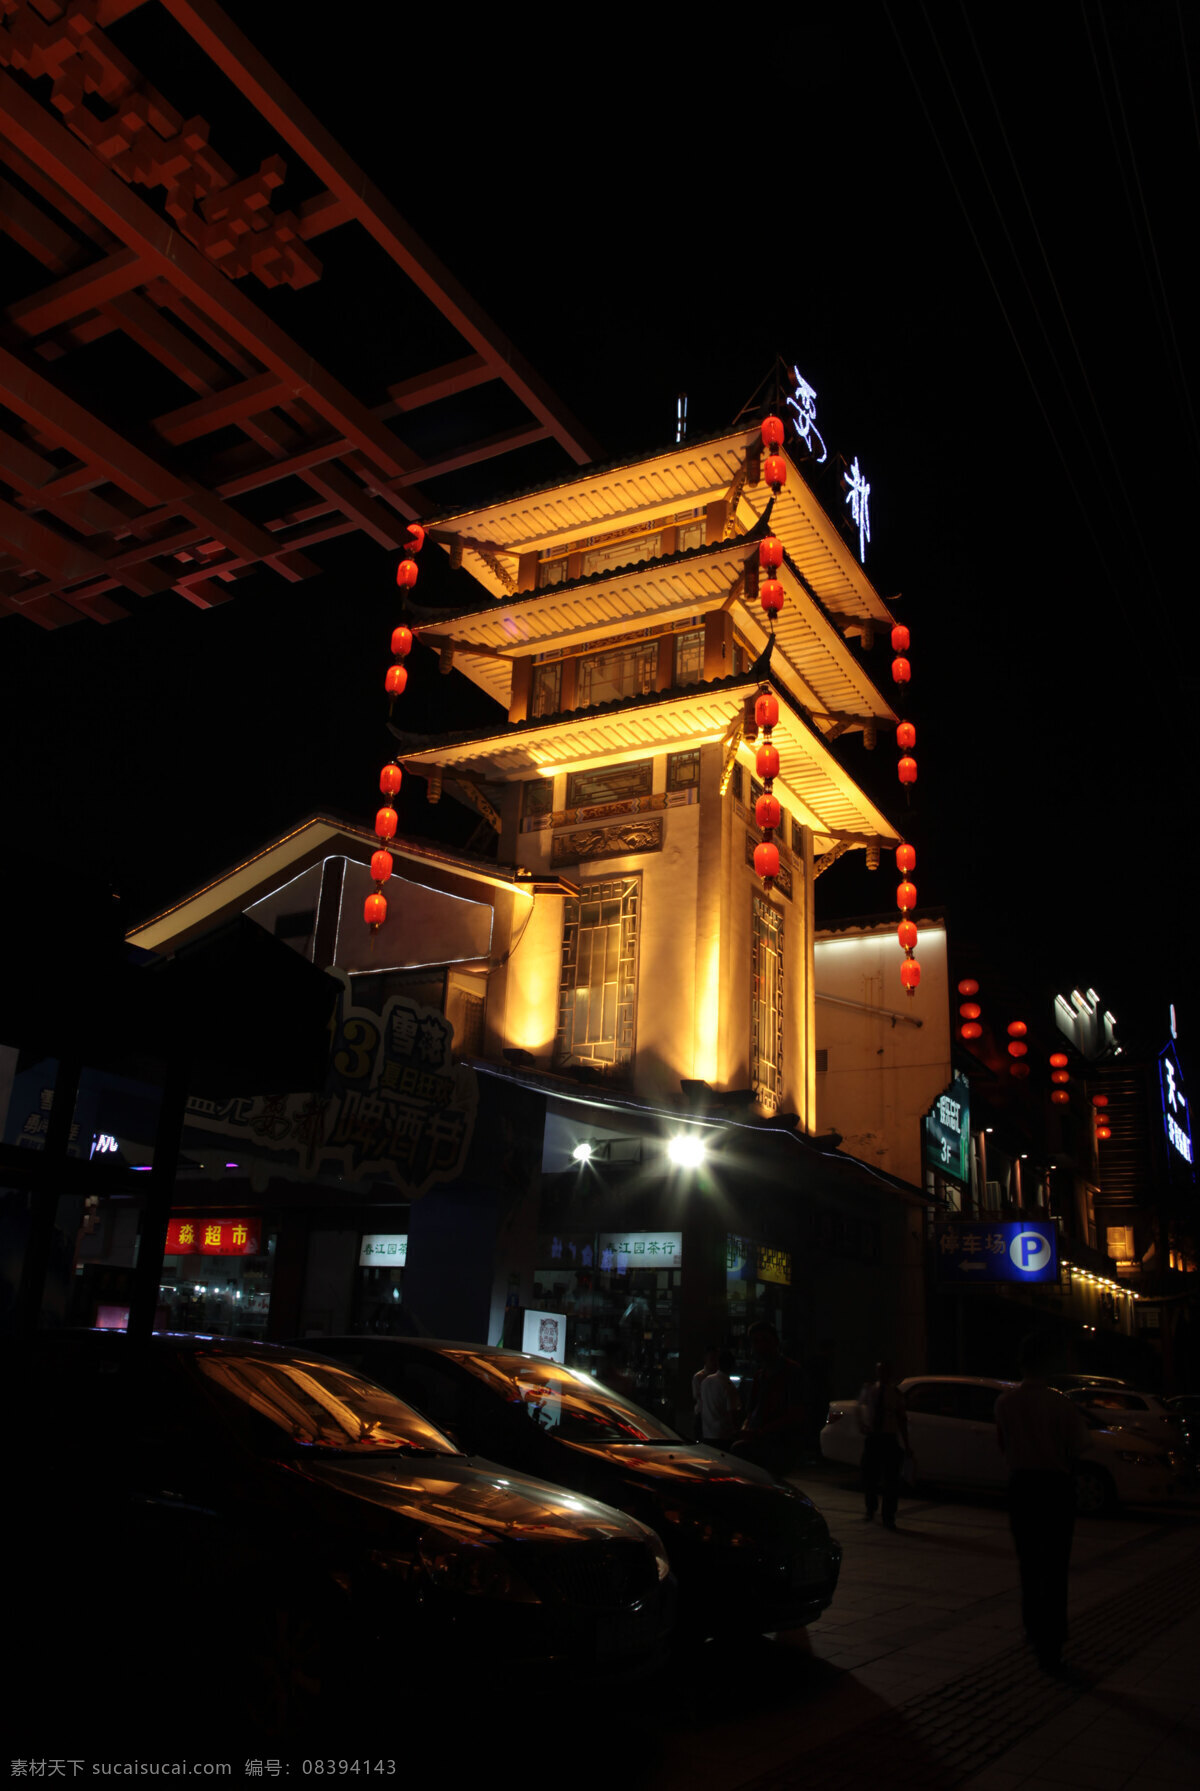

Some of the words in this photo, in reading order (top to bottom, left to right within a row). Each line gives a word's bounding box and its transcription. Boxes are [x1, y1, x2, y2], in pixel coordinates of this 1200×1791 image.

[391, 1007, 447, 1064] 雪花
[382, 1060, 456, 1107] 夏日狂欢
[332, 1090, 464, 1170] 啤酒节
[941, 1137, 952, 1164] 3F
[166, 1223, 249, 1246] 淼超市
[939, 1232, 1007, 1255] 停车场
